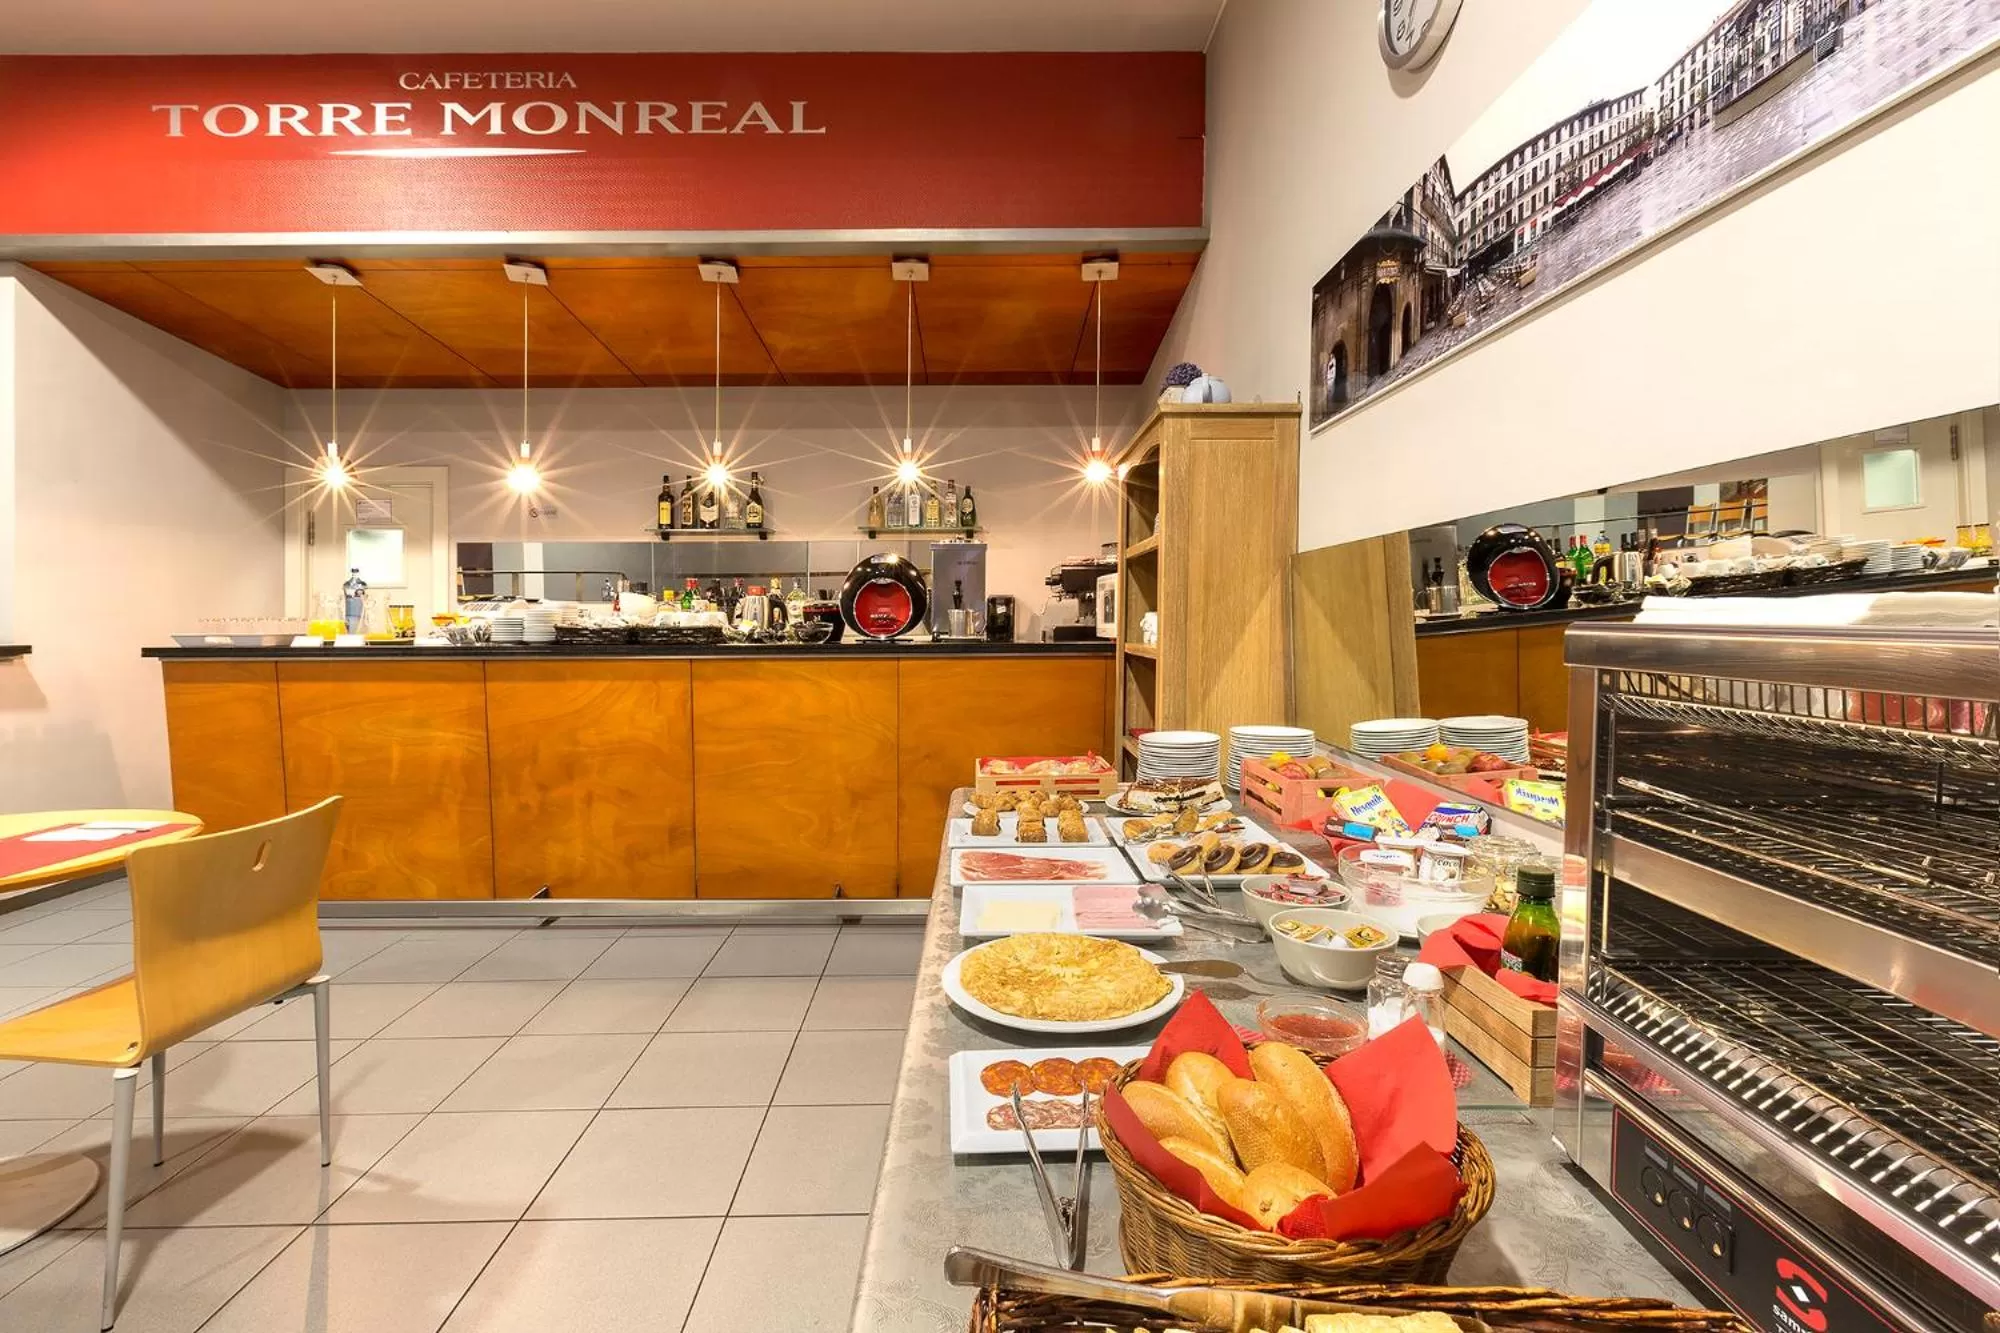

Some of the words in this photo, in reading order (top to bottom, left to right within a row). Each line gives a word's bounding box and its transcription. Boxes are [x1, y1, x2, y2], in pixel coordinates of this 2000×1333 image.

[399, 72, 577, 90] CAFETERIA
[151, 101, 412, 137] TORRE
[440, 100, 827, 136] MONREAL
